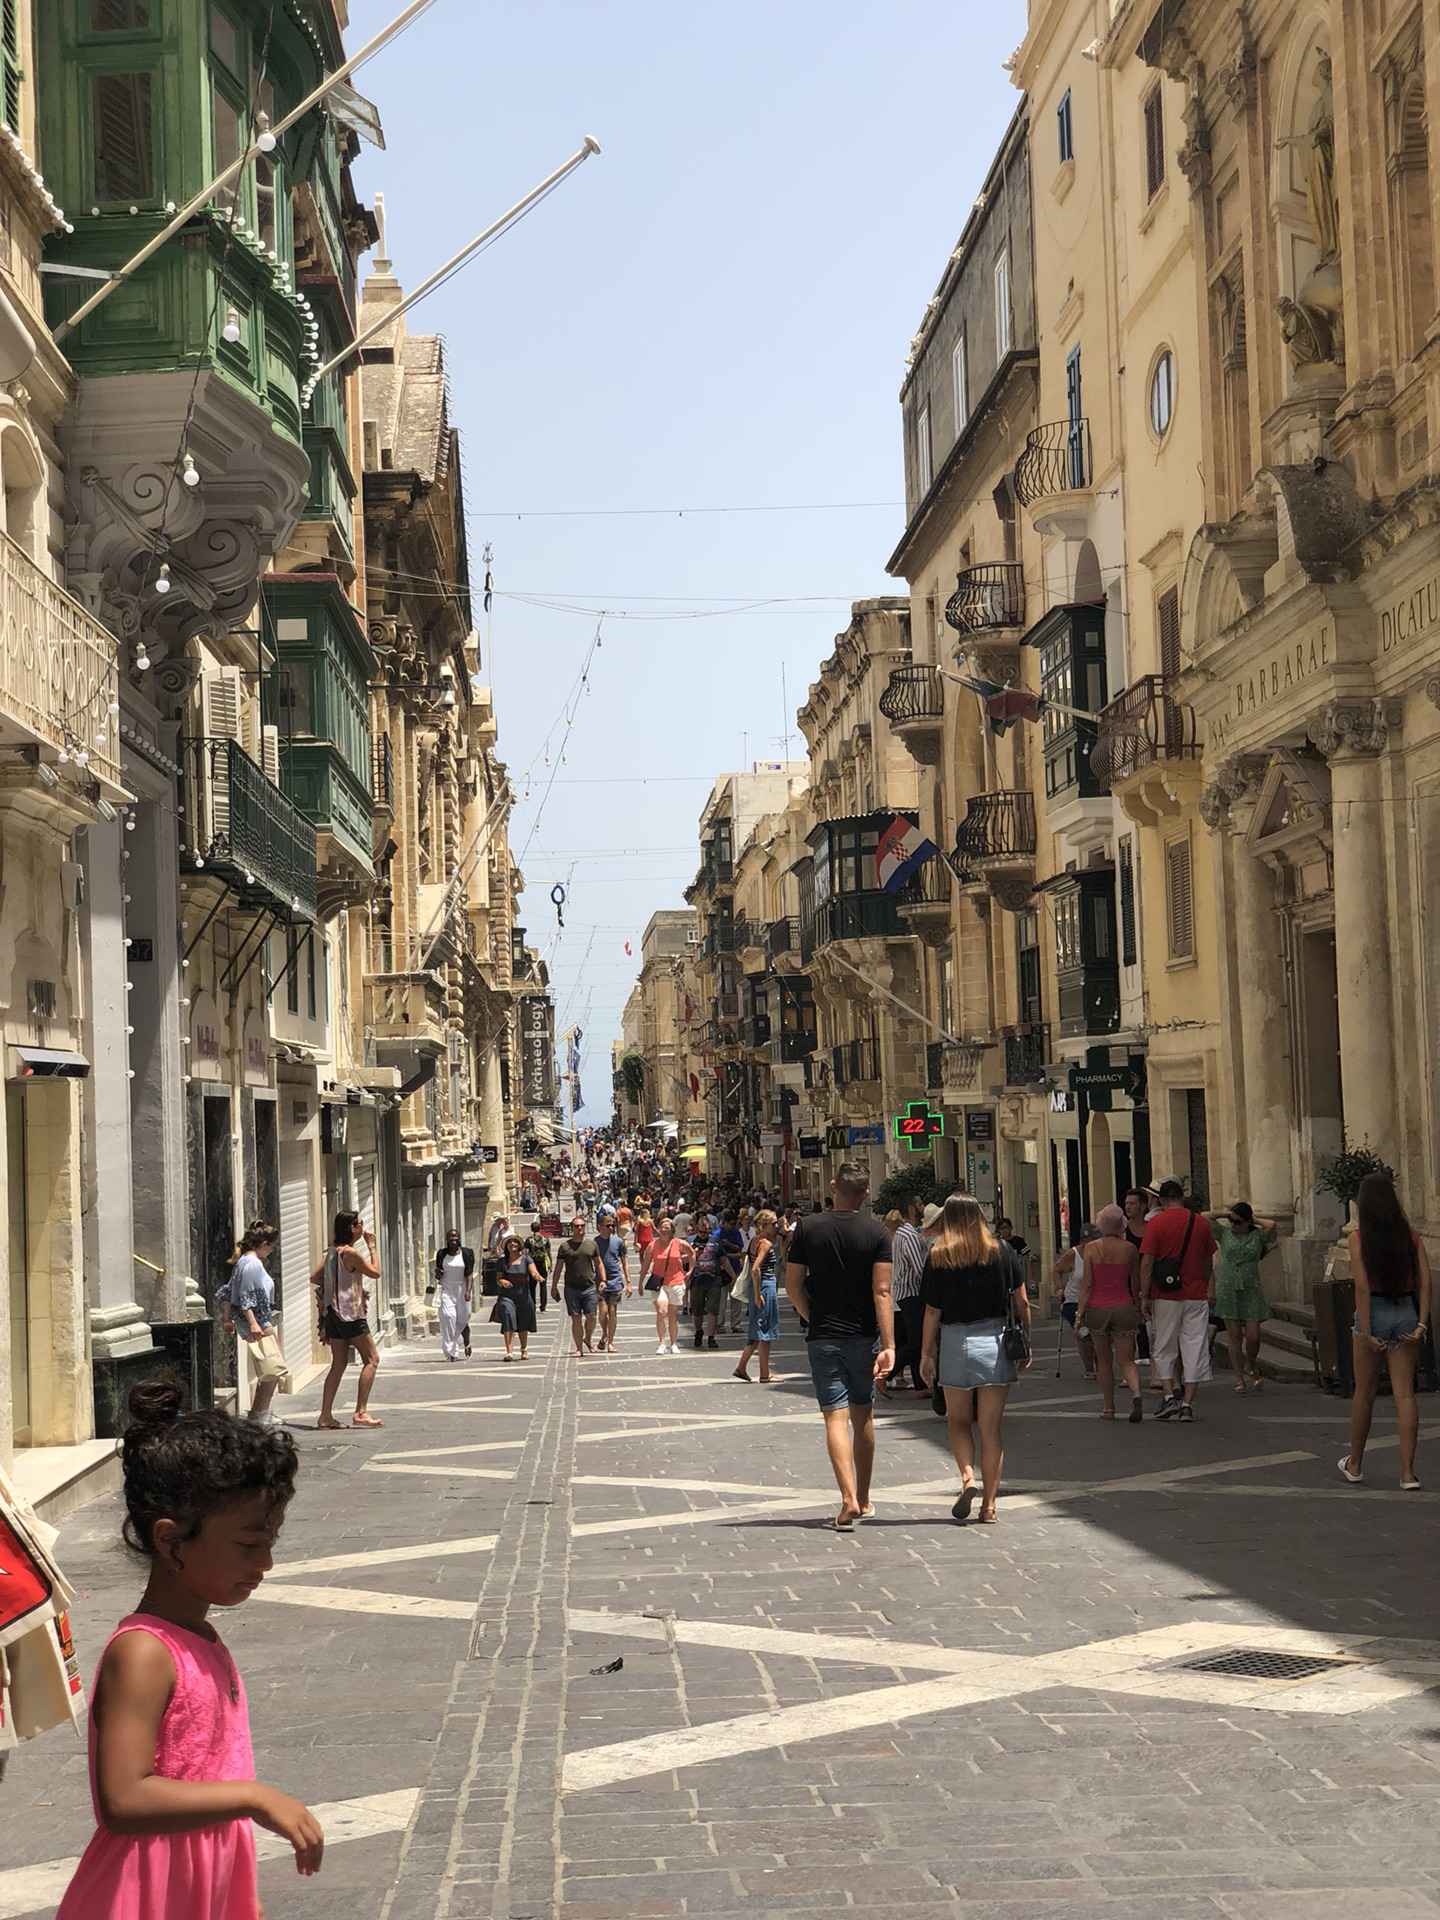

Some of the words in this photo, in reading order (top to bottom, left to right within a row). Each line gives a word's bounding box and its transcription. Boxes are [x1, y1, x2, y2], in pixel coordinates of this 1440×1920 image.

[1236, 626, 1329, 716] BARBARAE
[1076, 1072, 1122, 1084] PHARMACY
[903, 1119, 925, 1133] 22
[967, 1152, 977, 1196] HARMACY
